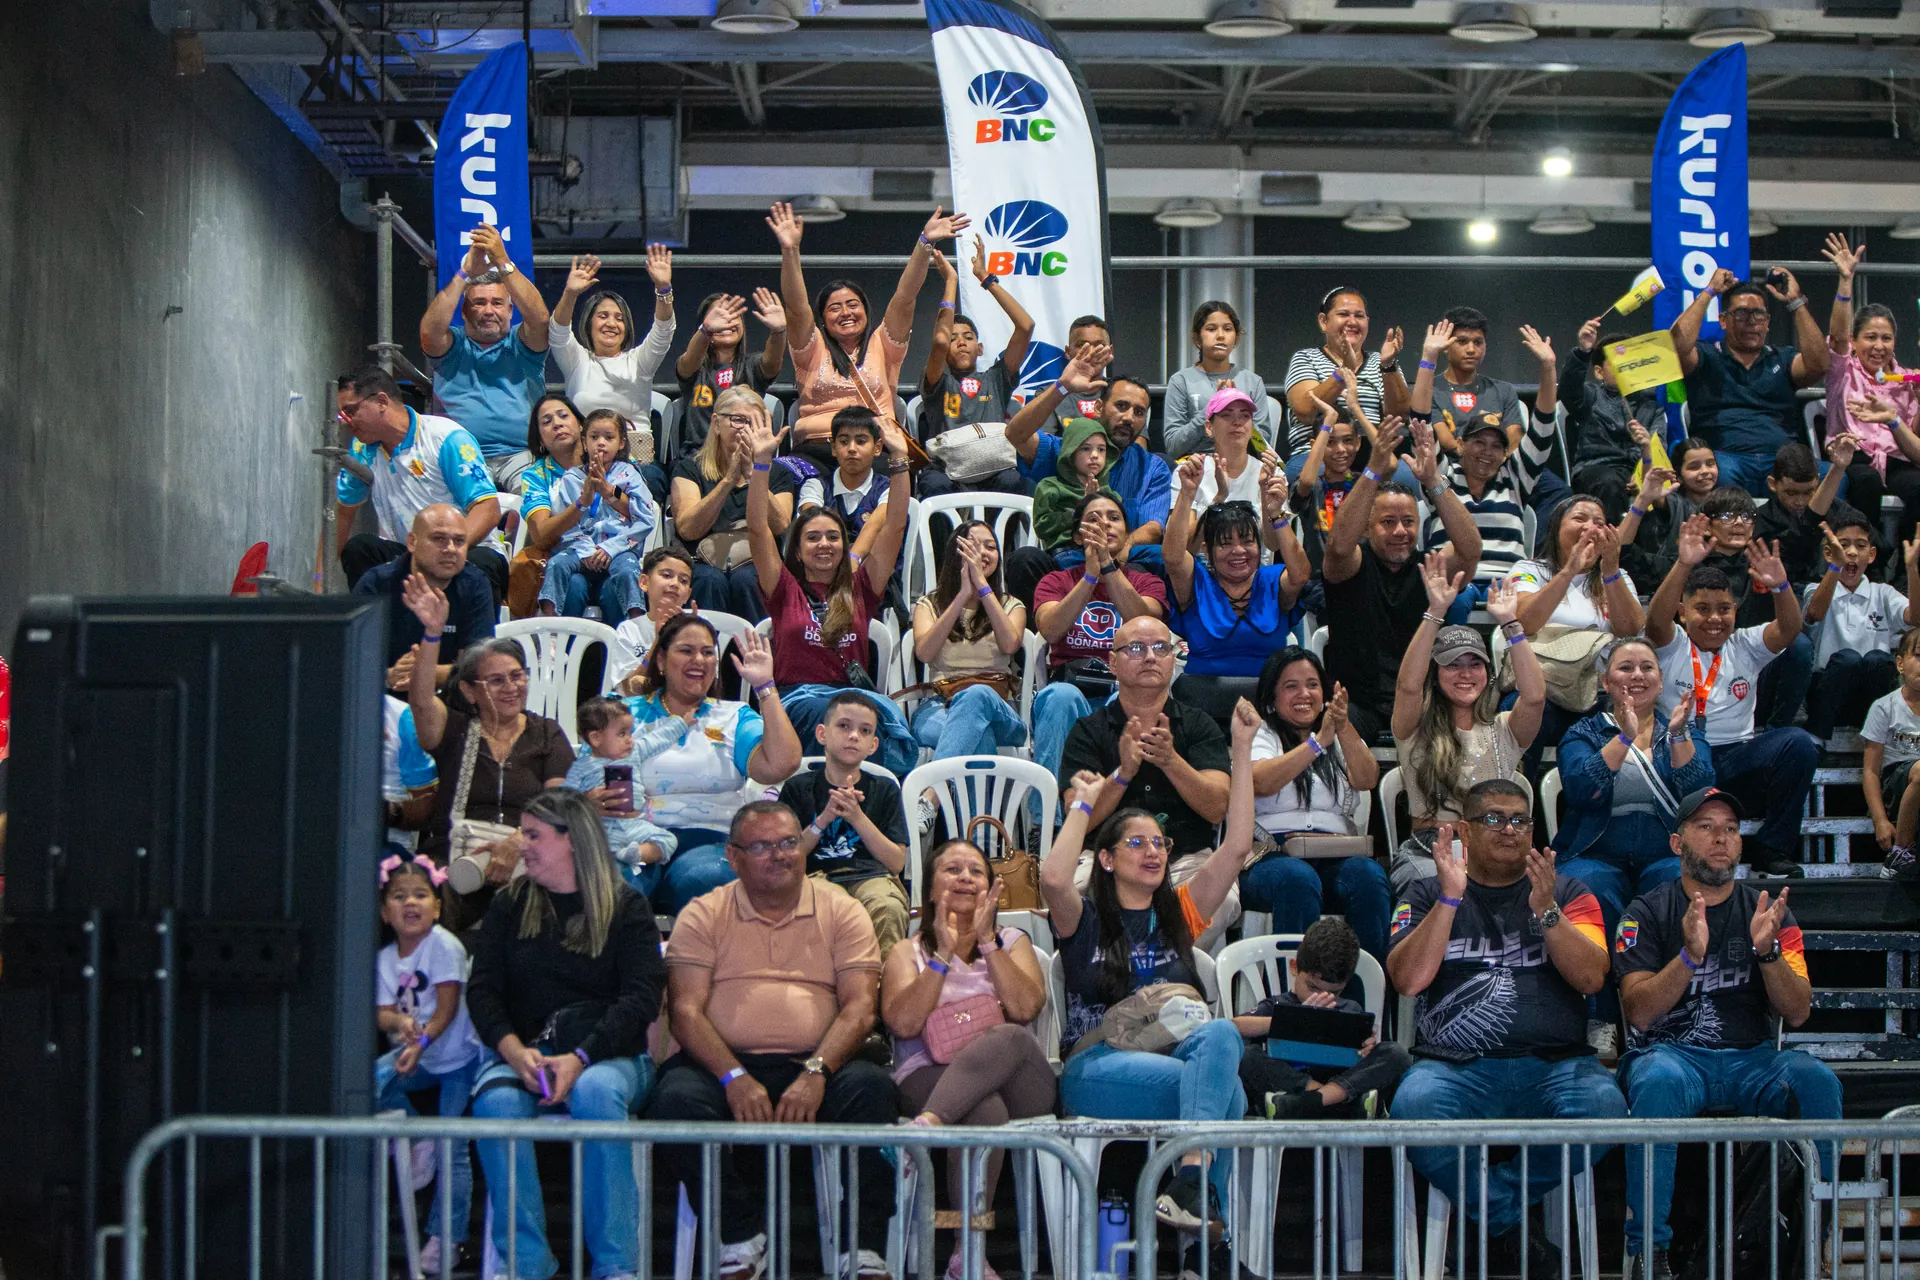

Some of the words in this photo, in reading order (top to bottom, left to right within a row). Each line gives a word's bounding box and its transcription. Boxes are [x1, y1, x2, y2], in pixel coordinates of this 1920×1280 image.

[976, 119, 1056, 144] BNC
[987, 251, 1068, 277] BNC
[1066, 637, 1114, 649] DONALD
[1690, 964, 1752, 996] TECH
